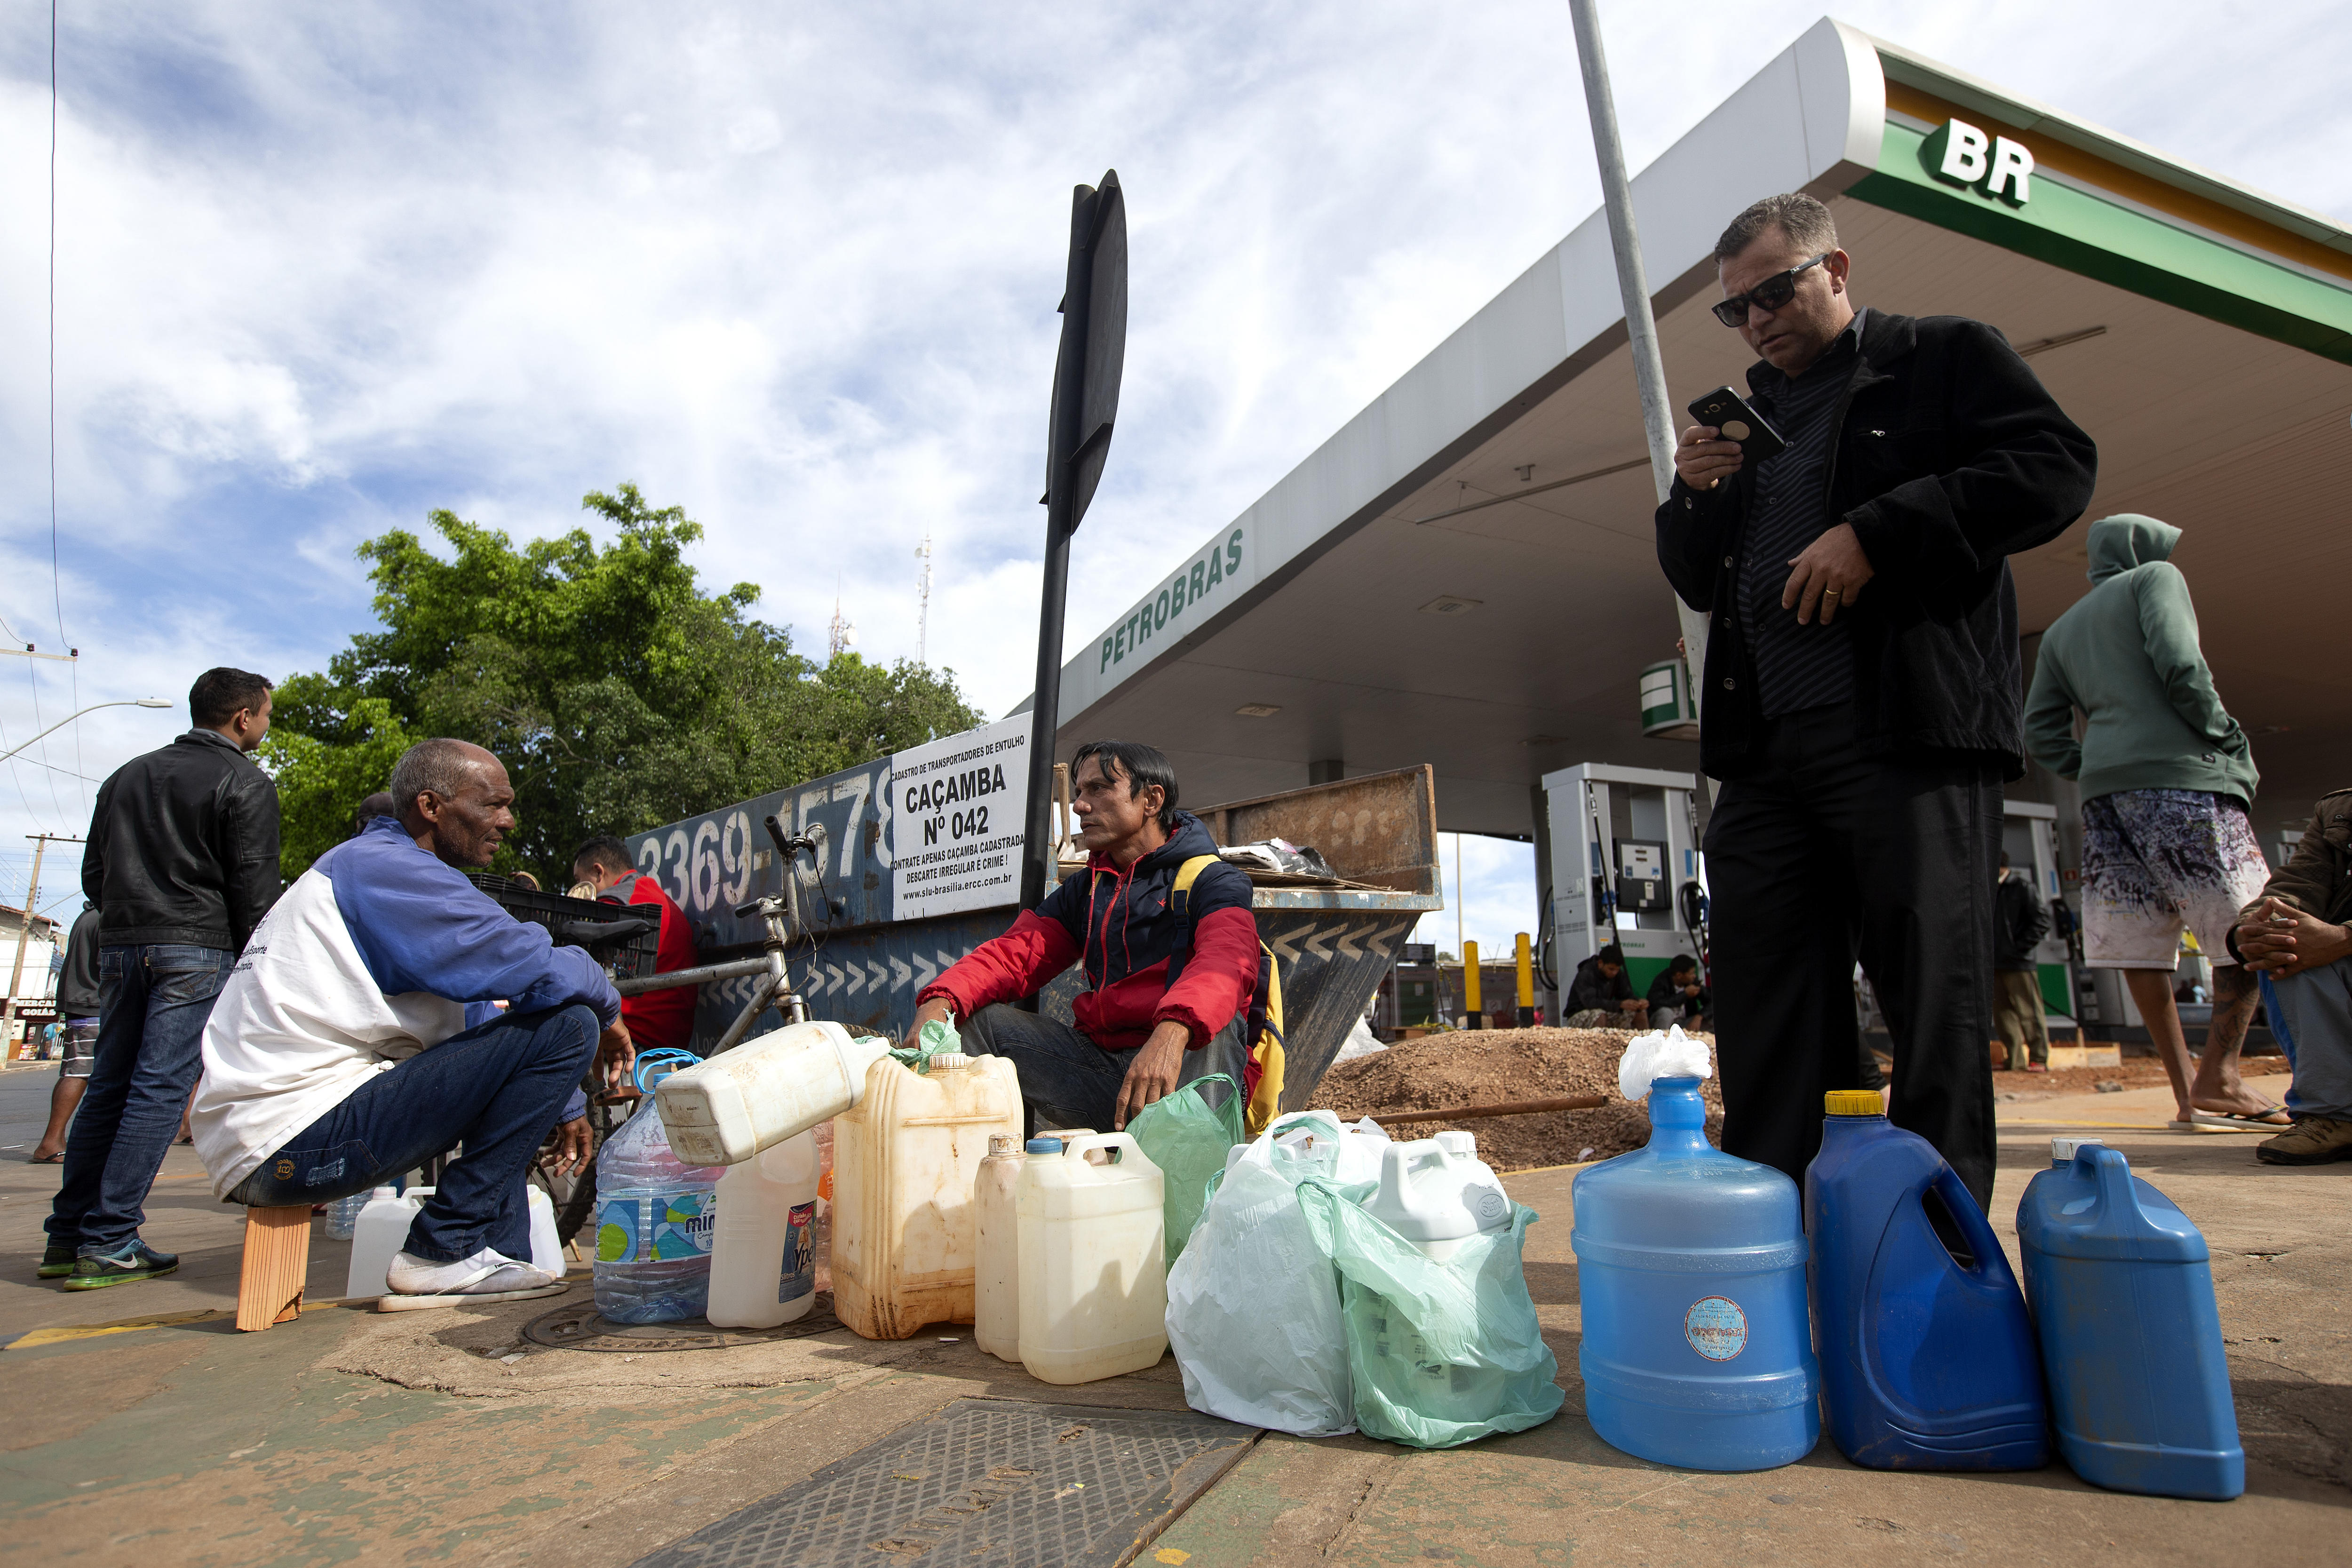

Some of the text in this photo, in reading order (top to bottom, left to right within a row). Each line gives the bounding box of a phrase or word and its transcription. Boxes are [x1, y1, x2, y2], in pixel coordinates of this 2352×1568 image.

[1940, 117, 2035, 203] BR
[1100, 528, 1243, 675] PETROBRAS
[891, 735, 1025, 782] CADASTRO DE TRANSPORTADORES DE ENTULHO
[906, 763, 1007, 814] CAÇAMBA
[952, 805, 989, 840] 042
[890, 834, 1024, 871] CONTRATE APENAS CAÇAMBA CADASTRADA
[906, 868, 938, 884] DESCARTE
[939, 861, 975, 878] IRREGULAR
[977, 856, 981, 871] É
[983, 858, 1004, 870] CRIME
[903, 873, 1012, 900] www.slu-brasilia.ercc.com.br
